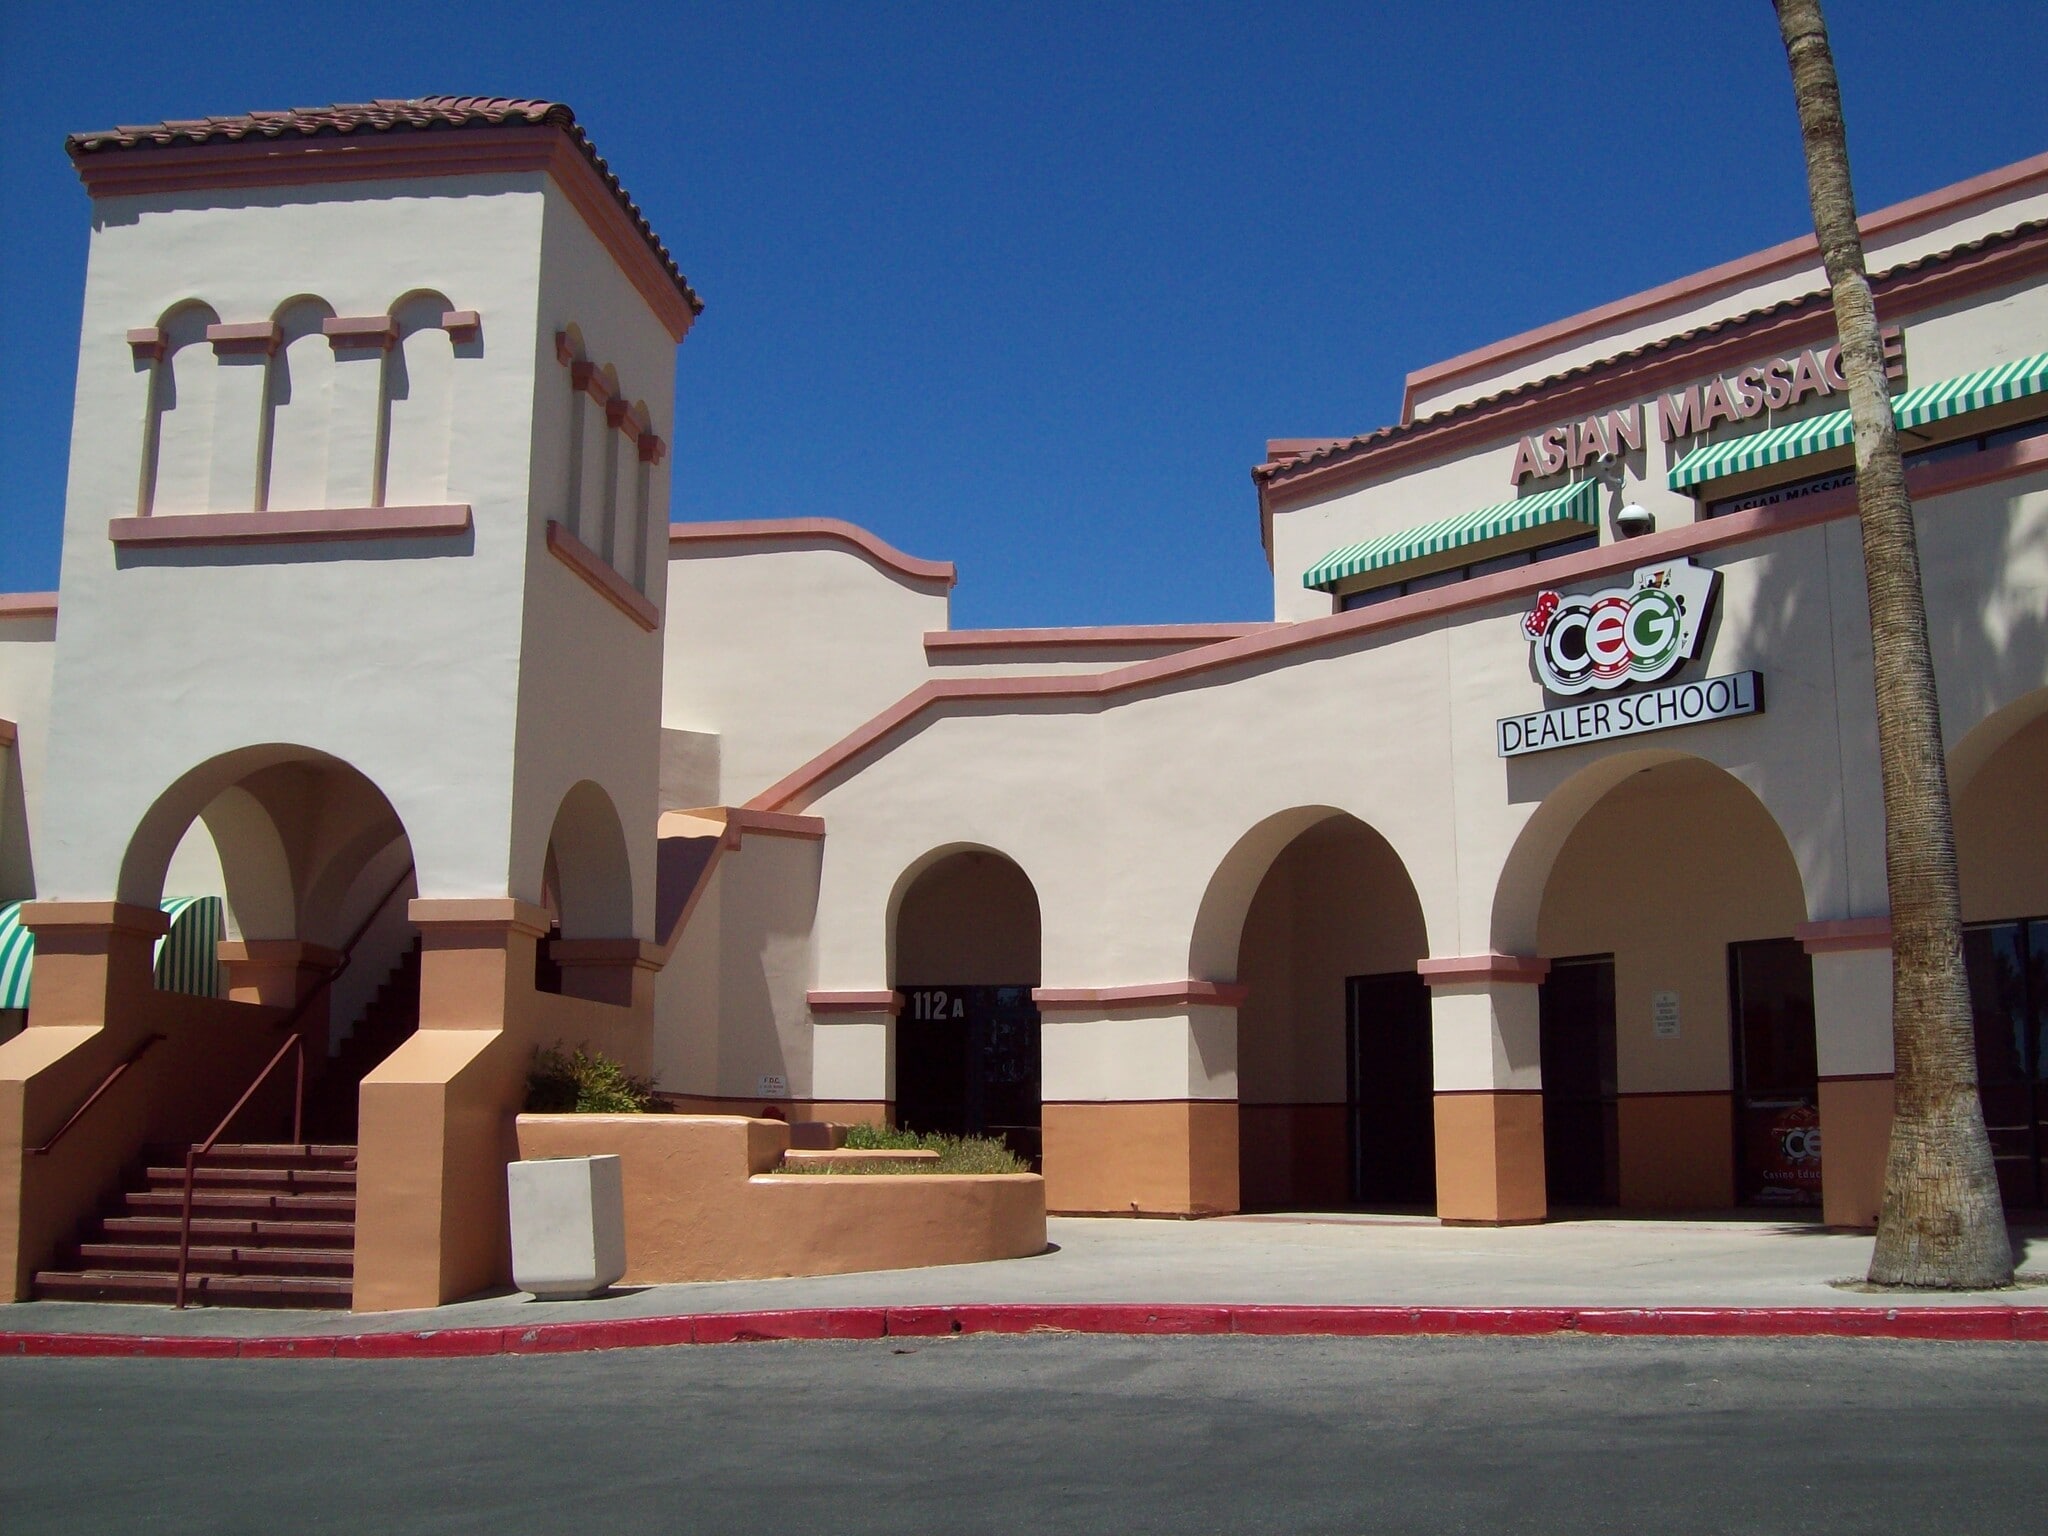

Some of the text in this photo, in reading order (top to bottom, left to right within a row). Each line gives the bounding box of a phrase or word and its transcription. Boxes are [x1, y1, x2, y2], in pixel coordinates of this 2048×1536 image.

[1510, 403, 1641, 486] ASIAN
[1502, 677, 1750, 752] DEALER SCHOOL
[913, 990, 965, 1020] 112 A
[1762, 1169, 1794, 1179] Casino
